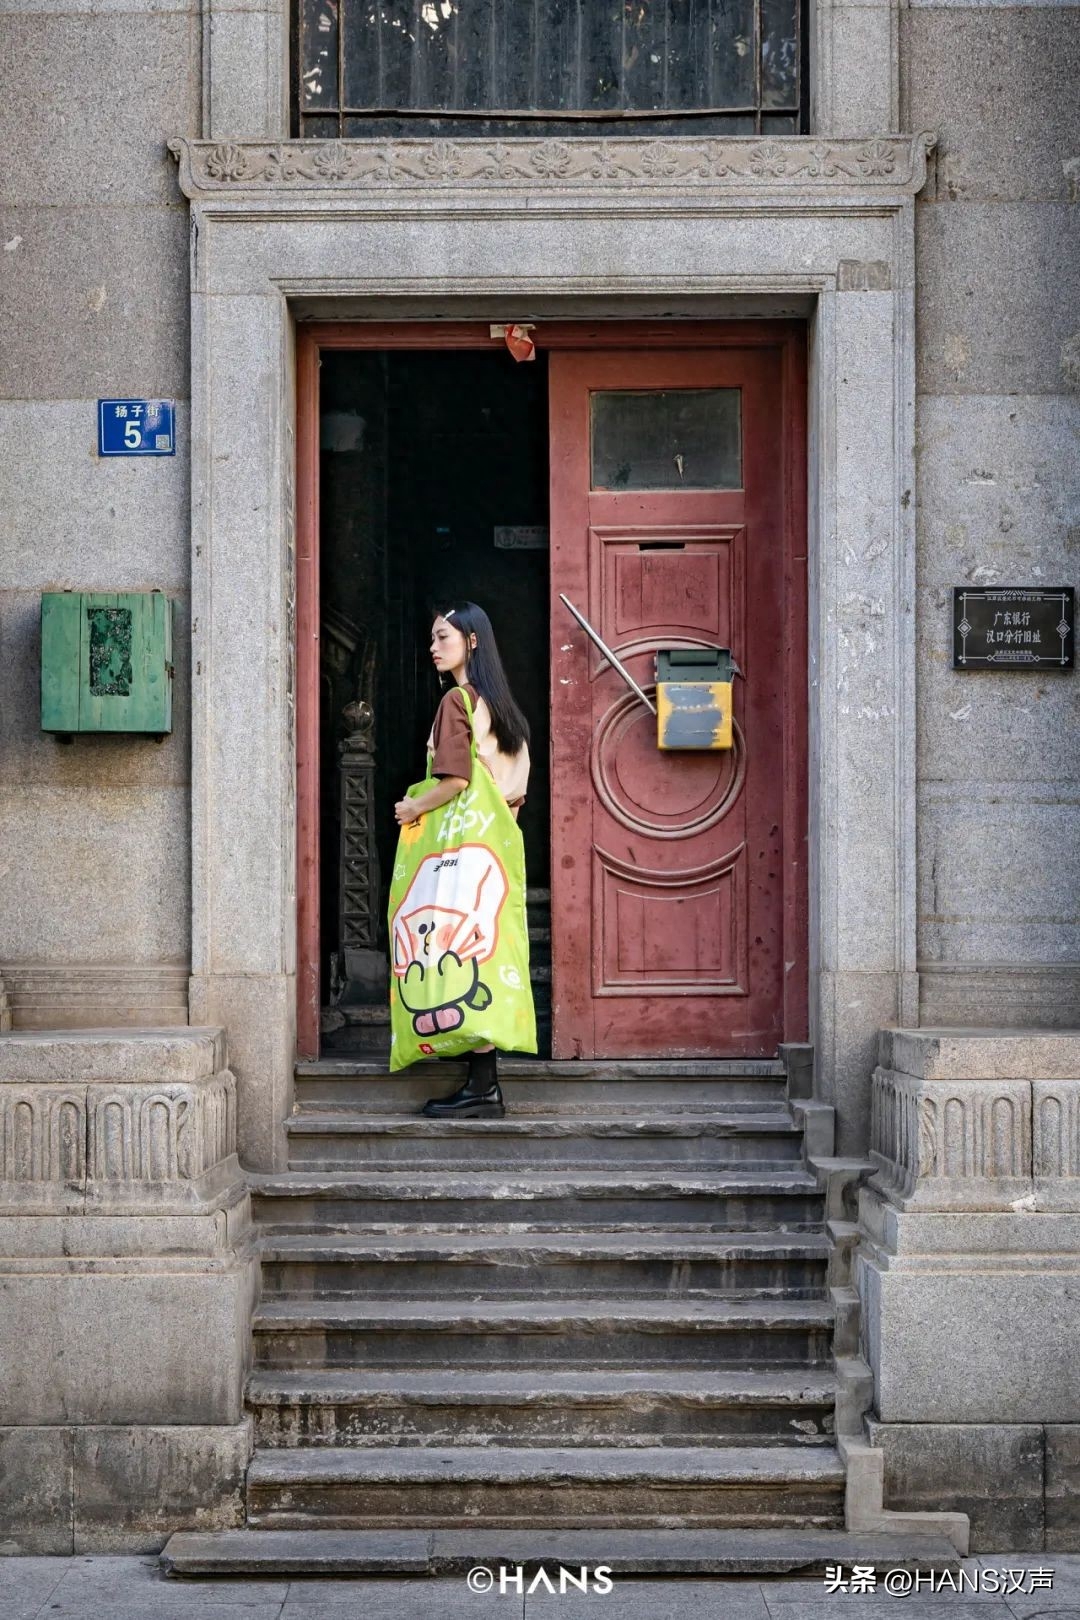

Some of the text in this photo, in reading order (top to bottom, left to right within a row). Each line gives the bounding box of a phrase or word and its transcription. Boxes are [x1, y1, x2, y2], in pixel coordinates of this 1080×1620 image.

[114, 405, 159, 418] 扬子街
[124, 420, 142, 449] 5
[993, 611, 1031, 627] 广东银行
[986, 629, 1042, 644] 汉口分行旧址
